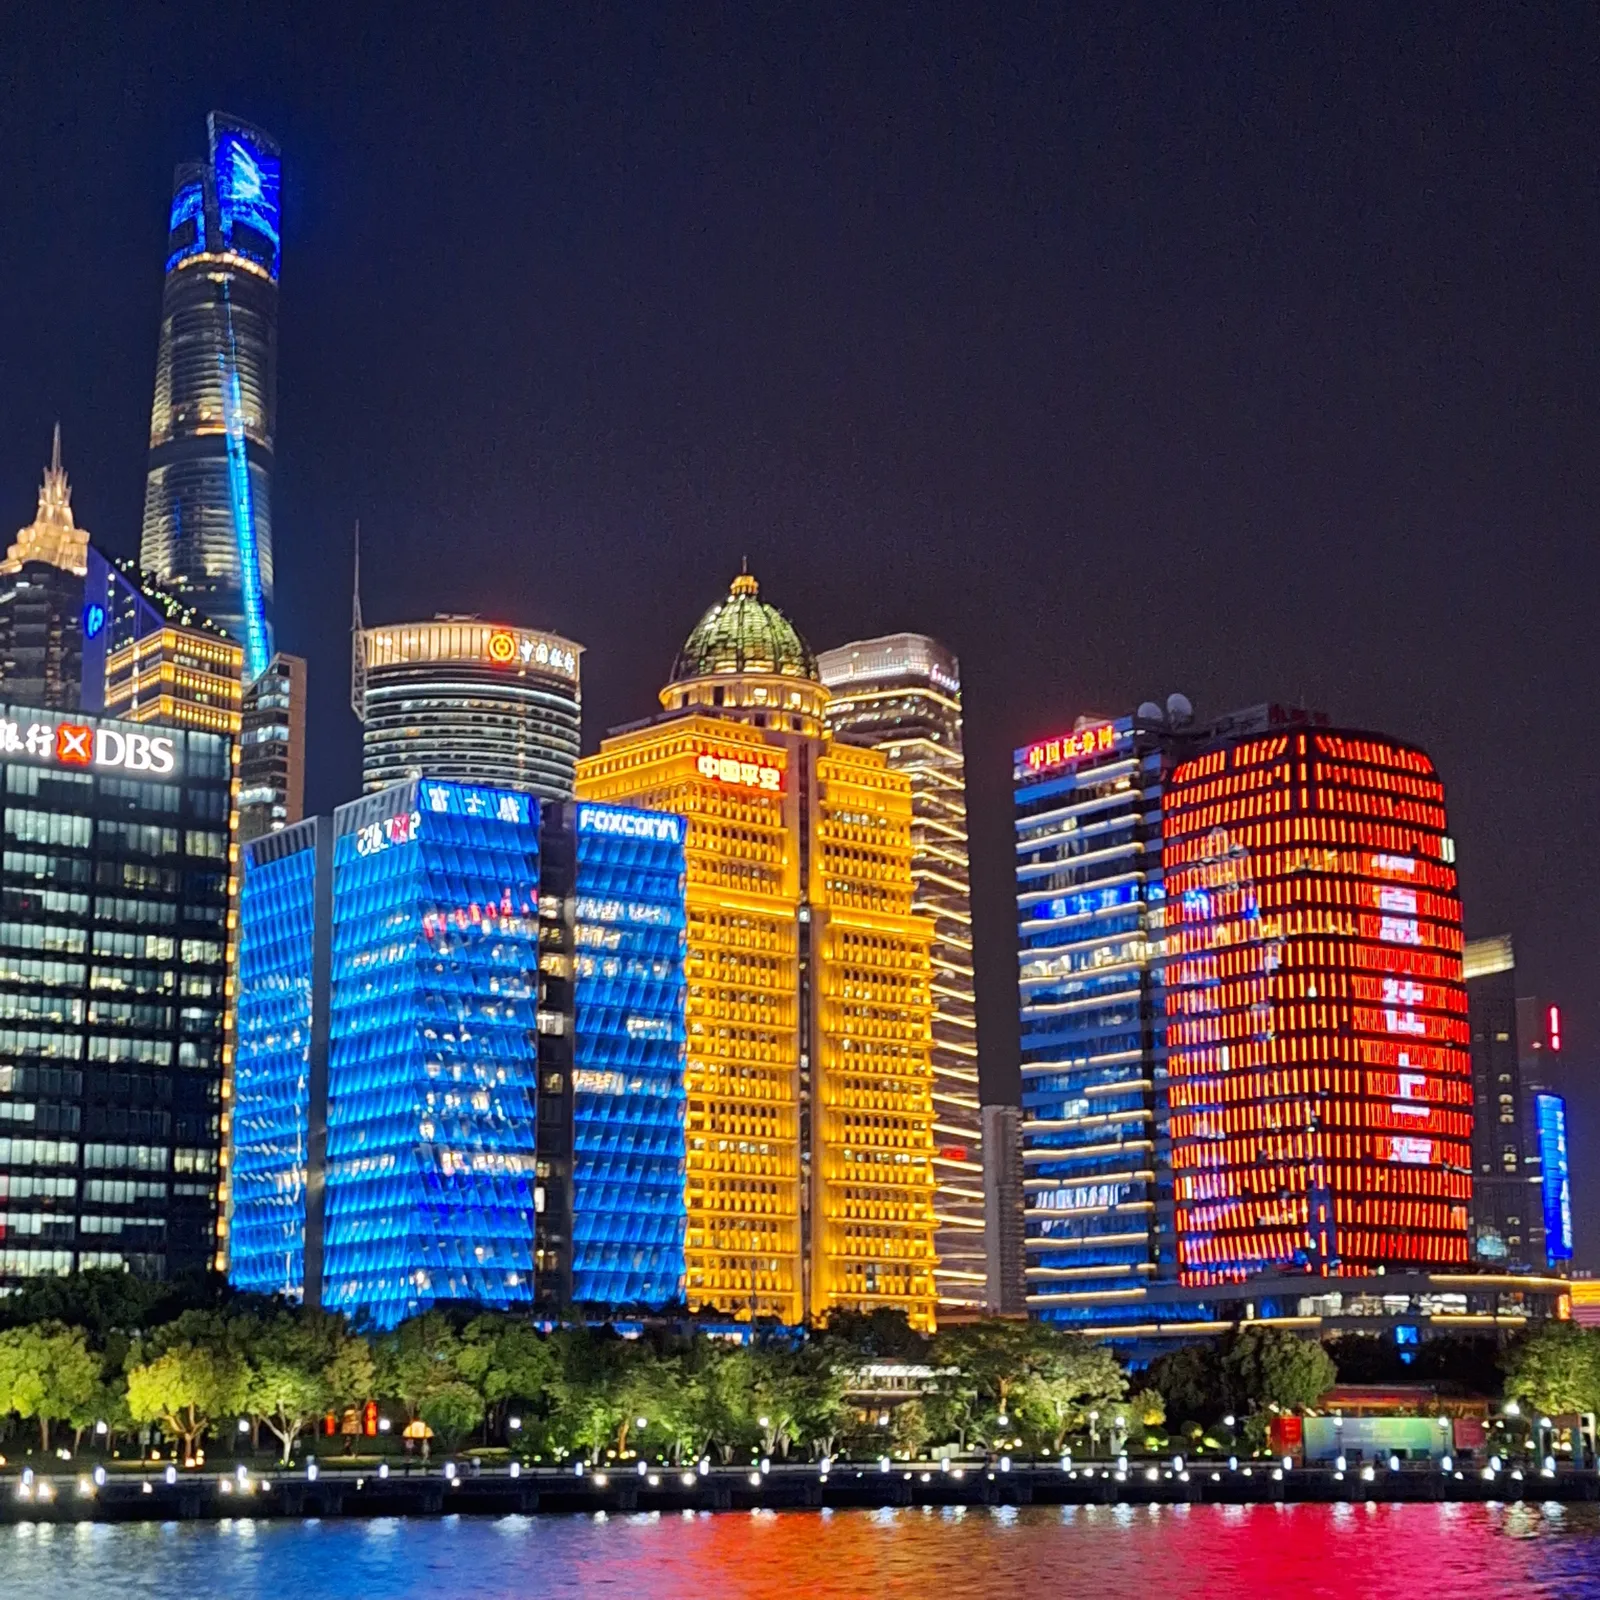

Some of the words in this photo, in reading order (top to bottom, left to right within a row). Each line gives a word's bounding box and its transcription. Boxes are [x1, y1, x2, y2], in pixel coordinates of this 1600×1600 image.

[96, 729, 174, 772] DBS
[698, 755, 780, 791] 中国平安
